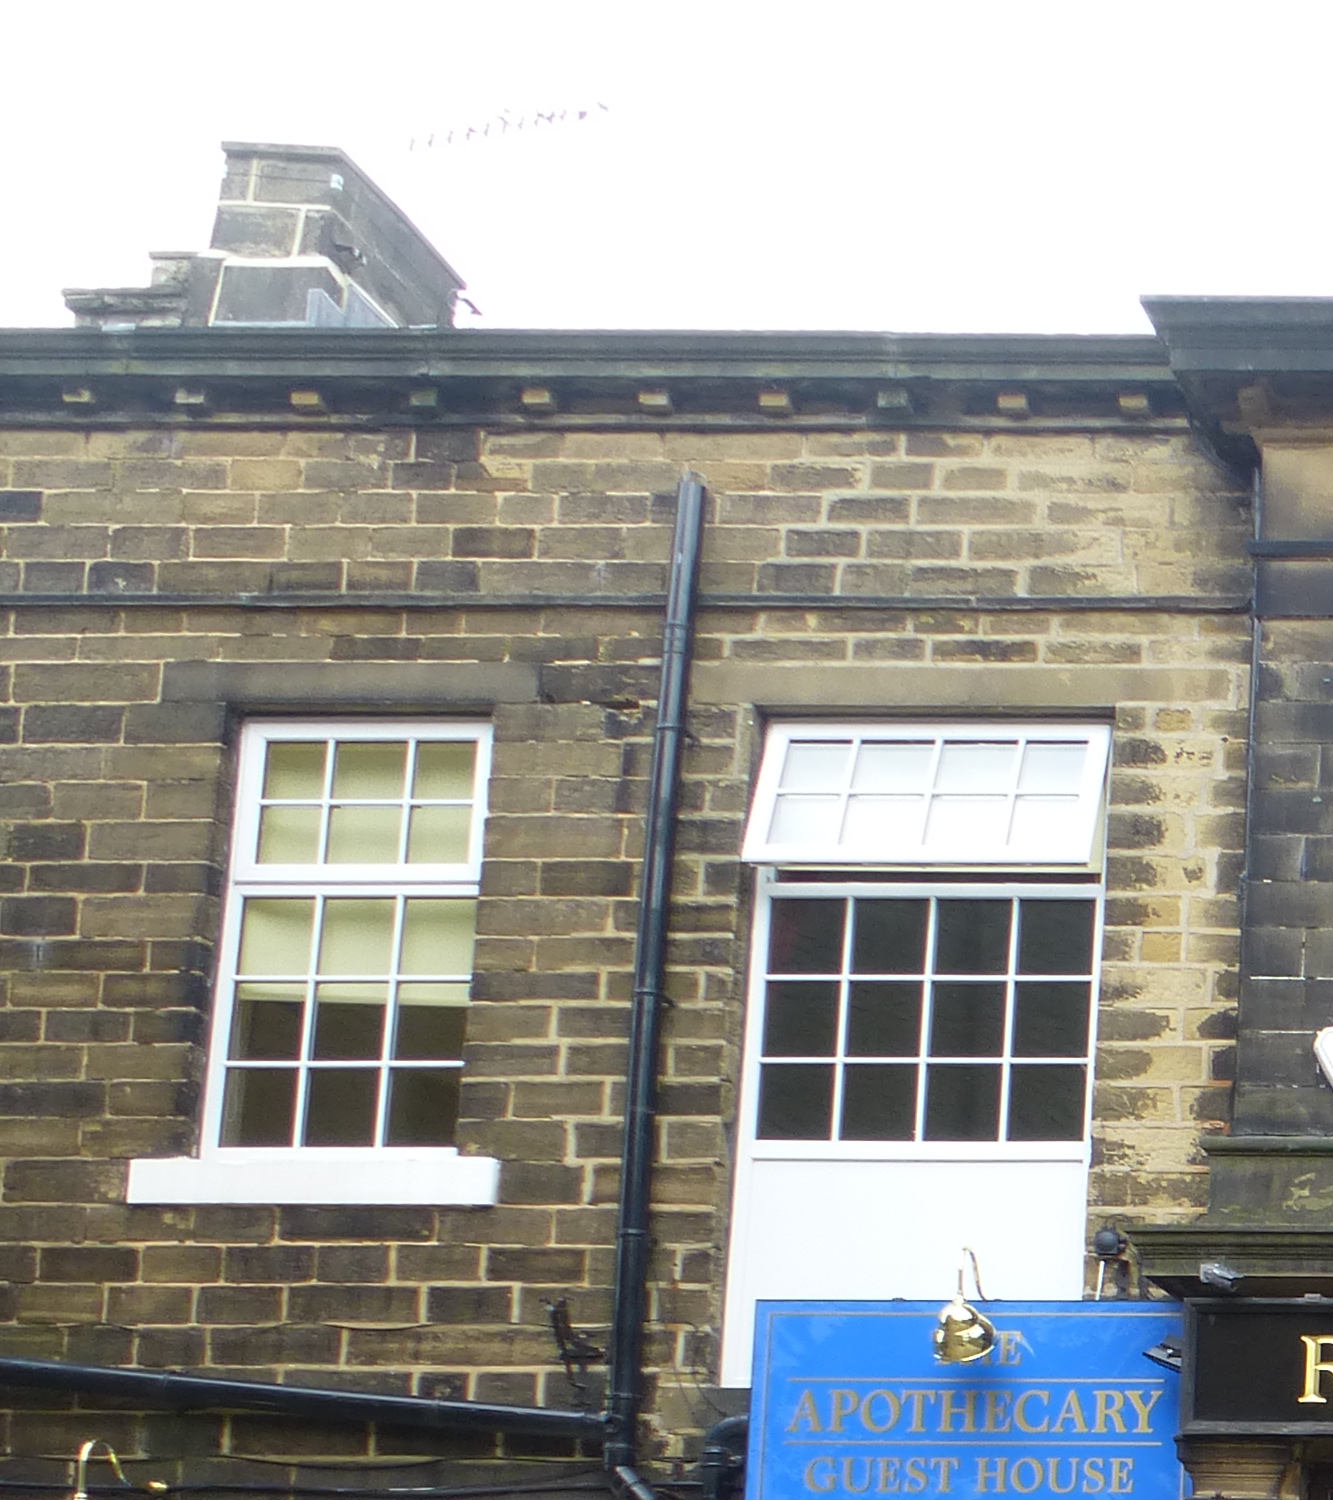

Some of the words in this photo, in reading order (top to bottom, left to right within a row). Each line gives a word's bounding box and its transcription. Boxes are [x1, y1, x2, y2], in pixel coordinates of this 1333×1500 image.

[785, 1389, 1163, 1434] APOTHECARY
[804, 1457, 960, 1494] GUEST
[976, 1458, 1134, 1494] HOUSE
